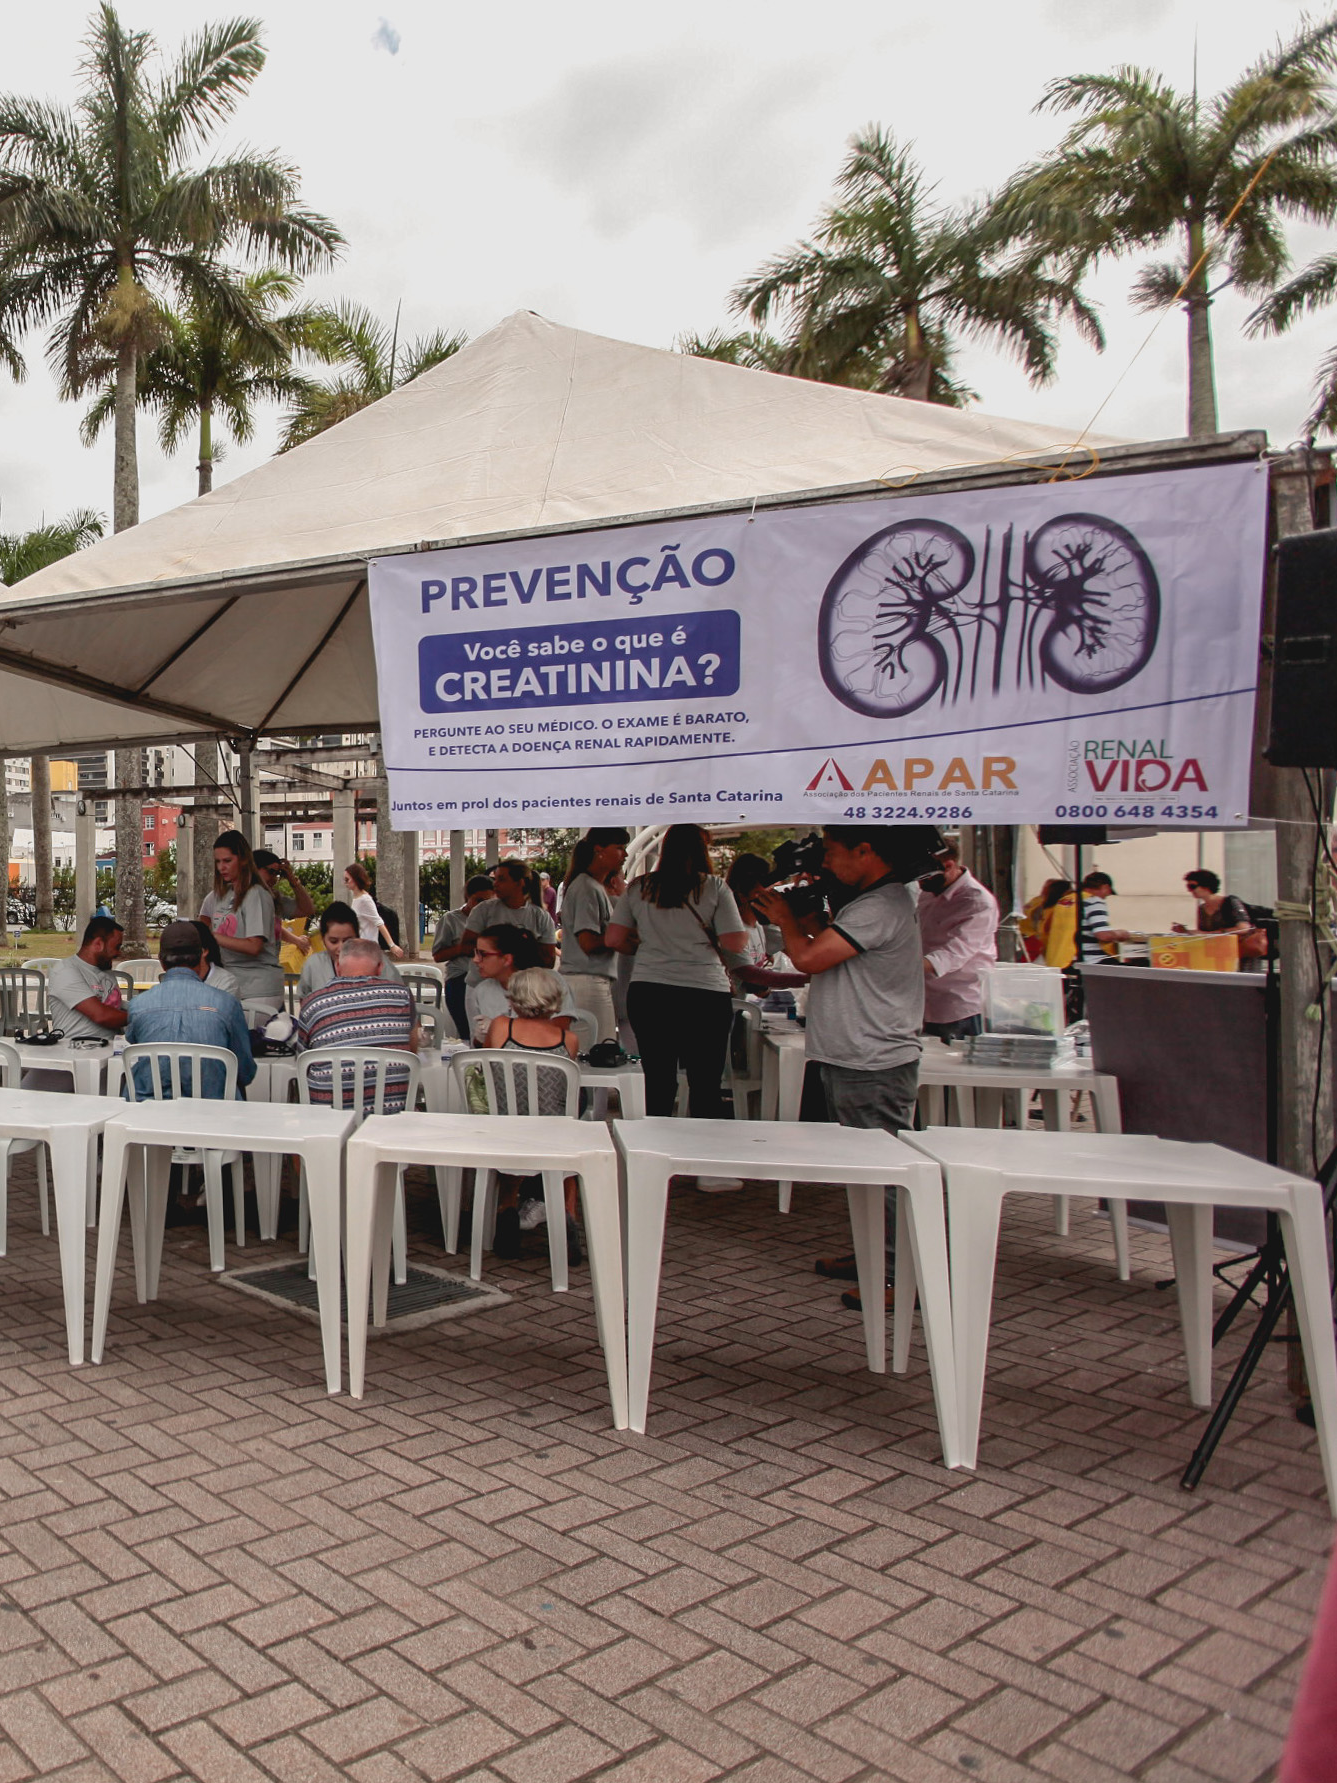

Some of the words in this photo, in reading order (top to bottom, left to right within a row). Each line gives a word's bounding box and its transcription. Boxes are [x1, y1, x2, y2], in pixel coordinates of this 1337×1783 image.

[421, 543, 735, 613] PREVENÇÃO
[463, 640, 521, 661] Você
[527, 635, 584, 656] sabe
[592, 637, 607, 651] o
[614, 632, 663, 655] que
[671, 625, 687, 645] é
[435, 653, 721, 703] CREATININA?
[414, 726, 482, 738] PERGUNTE
[485, 725, 505, 735] AO
[508, 723, 533, 734] SEU
[538, 719, 598, 732] MÉDICO.
[601, 719, 613, 729] O
[617, 715, 669, 729] EXAME
[673, 713, 681, 725] É
[685, 711, 749, 725] BARATO,
[428, 747, 436, 756] E
[439, 743, 496, 755] DETECTA
[499, 743, 509, 753] A
[512, 740, 572, 753] DOENÇA
[575, 738, 621, 750] RENAL
[624, 732, 735, 748] RAPIDAMENTE.
[1084, 739, 1174, 760] RENAL
[861, 756, 1018, 791] APAR
[1067, 740, 1081, 793] ASSOCIAÇÃO
[1084, 758, 1209, 792] VIDA
[391, 801, 433, 811] Juntos
[436, 801, 457, 810] em
[461, 798, 489, 813] prol
[493, 797, 518, 809] dos
[522, 796, 592, 811] pacientes
[595, 794, 641, 807] renais
[645, 792, 664, 805] de
[669, 791, 711, 804] Santa
[716, 789, 783, 802] Catarina
[803, 790, 848, 798] Associação
[910, 789, 939, 797] Renais
[942, 789, 952, 797] de
[955, 789, 979, 797] Santa
[843, 806, 866, 818] 48
[871, 806, 973, 819] 3224.9286
[1055, 805, 1108, 818] 0800
[1114, 805, 1155, 819] 648
[1161, 805, 1219, 819] 4354
